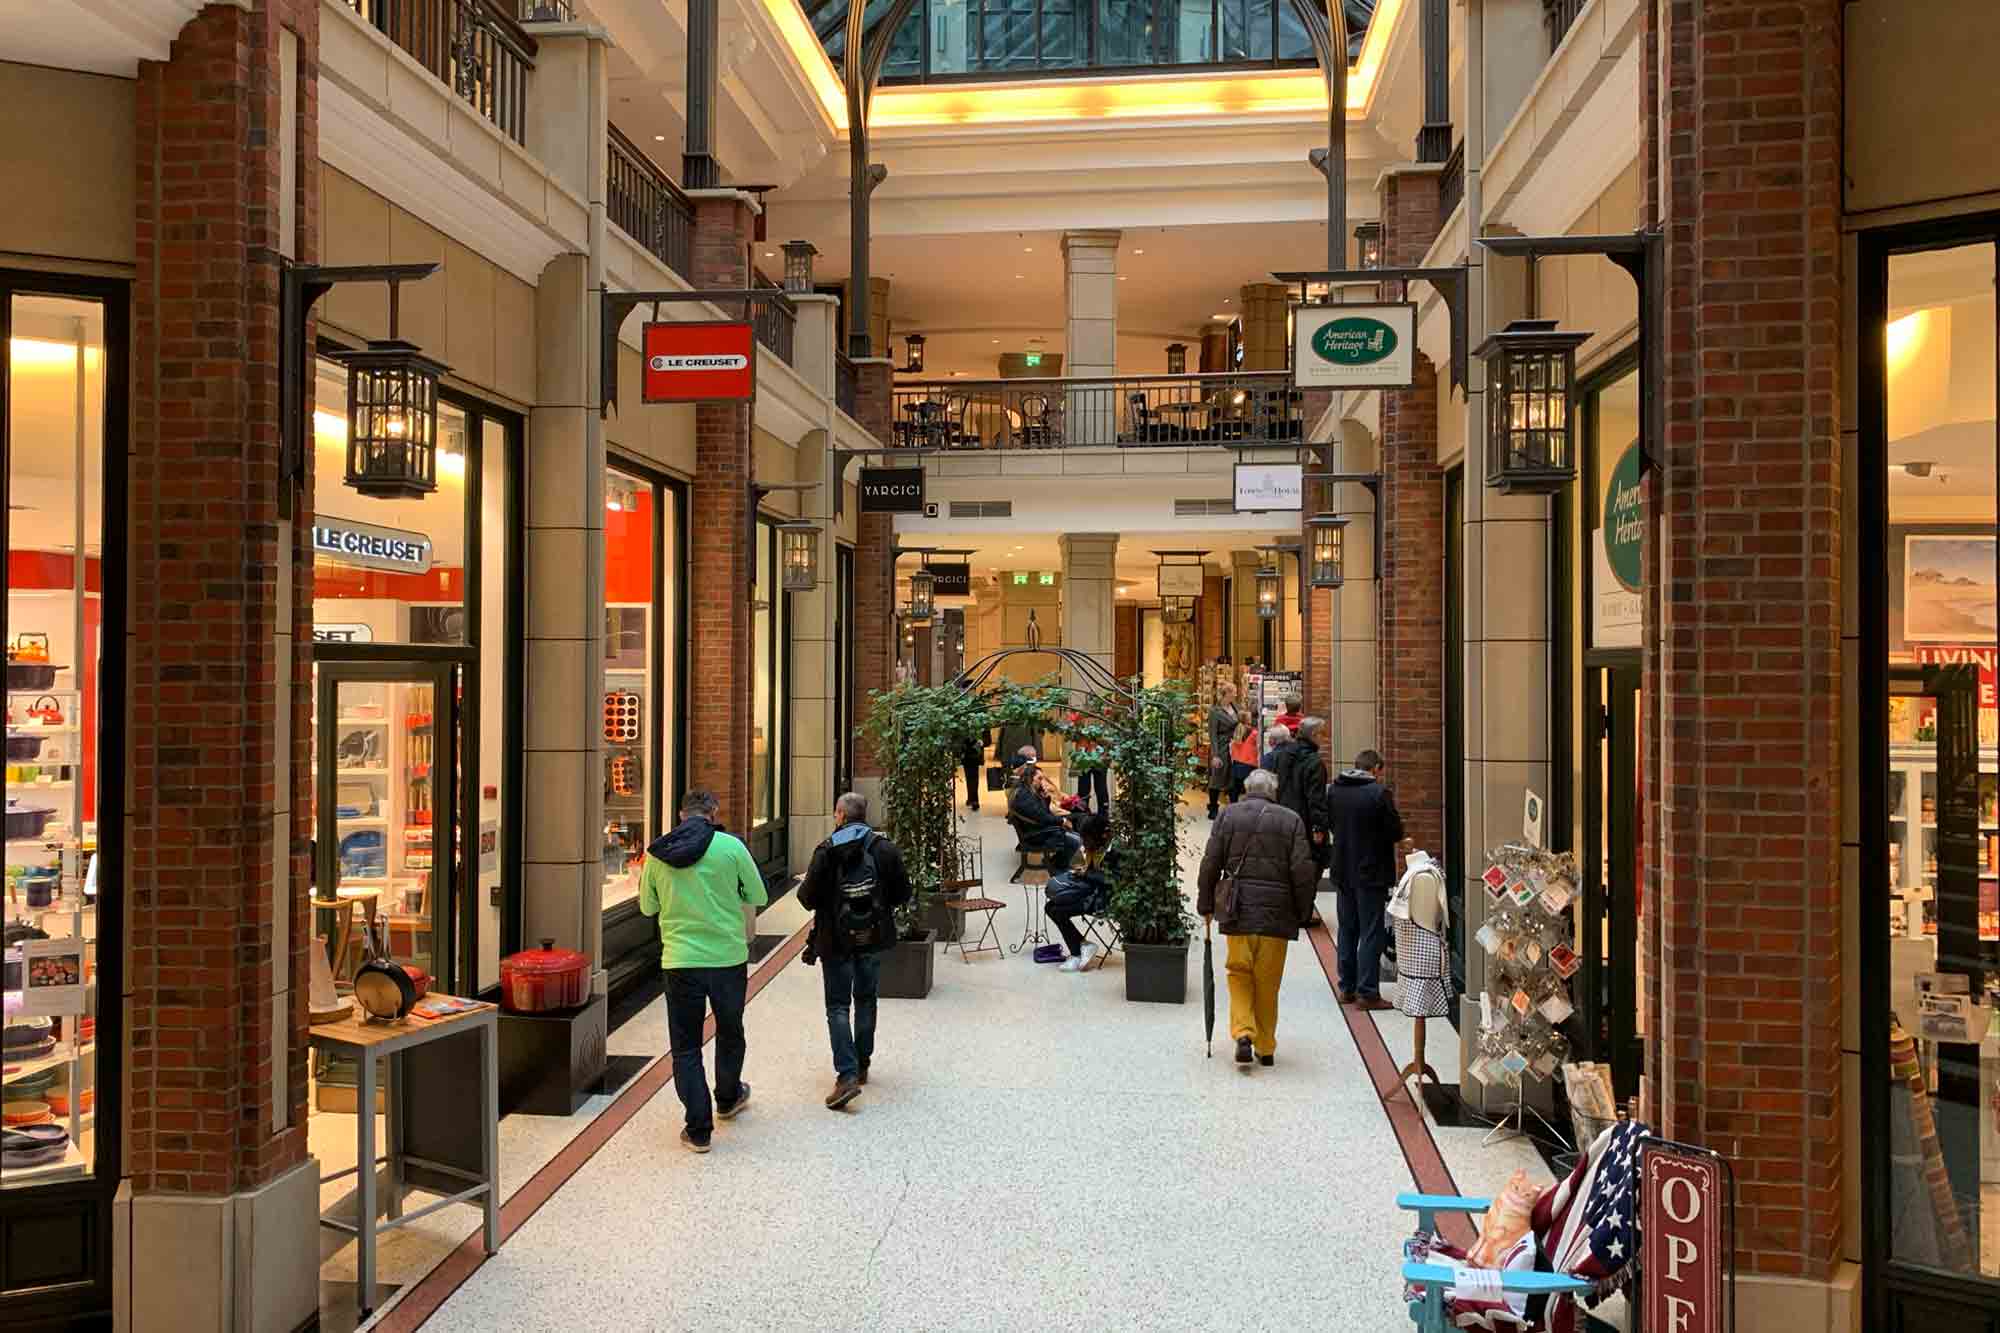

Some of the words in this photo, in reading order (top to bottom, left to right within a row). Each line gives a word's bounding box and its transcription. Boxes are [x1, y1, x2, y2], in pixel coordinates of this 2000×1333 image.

[1323, 328, 1367, 340] American
[1324, 340, 1364, 357] Heritage
[685, 358, 739, 366] CREUSET
[864, 485, 920, 496] YARGICI
[315, 527, 341, 550] LE
[343, 532, 425, 562] CREUSET
[932, 575, 968, 584] RGICI
[1920, 649, 1997, 672] LIVIN
